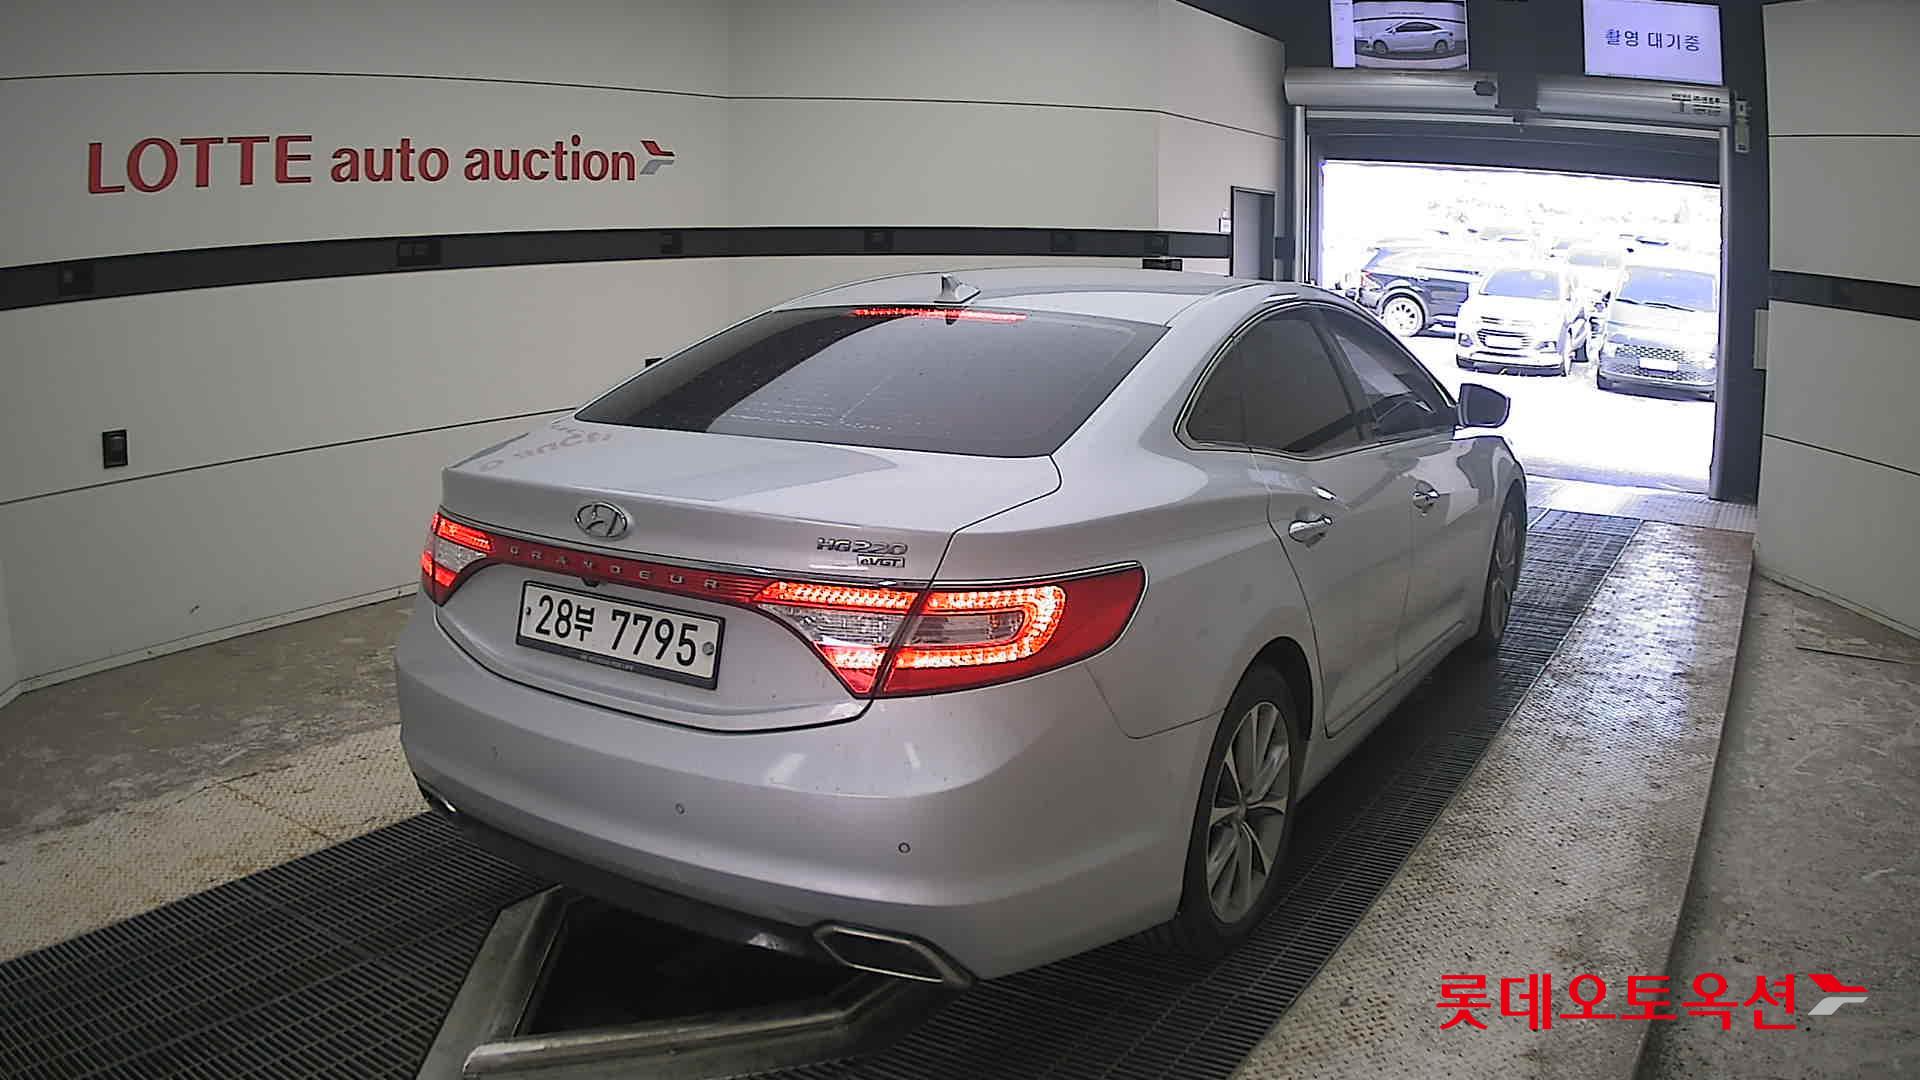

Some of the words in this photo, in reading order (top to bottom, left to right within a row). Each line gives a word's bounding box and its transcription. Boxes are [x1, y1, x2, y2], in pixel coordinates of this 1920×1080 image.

[1647, 31, 1700, 52] 대기중
[88, 134, 313, 194] LOTTE
[330, 138, 450, 182] auto
[463, 134, 636, 182] auction
[816, 537, 909, 556] HG220
[535, 594, 596, 642] 28부
[611, 608, 699, 667] 7795
